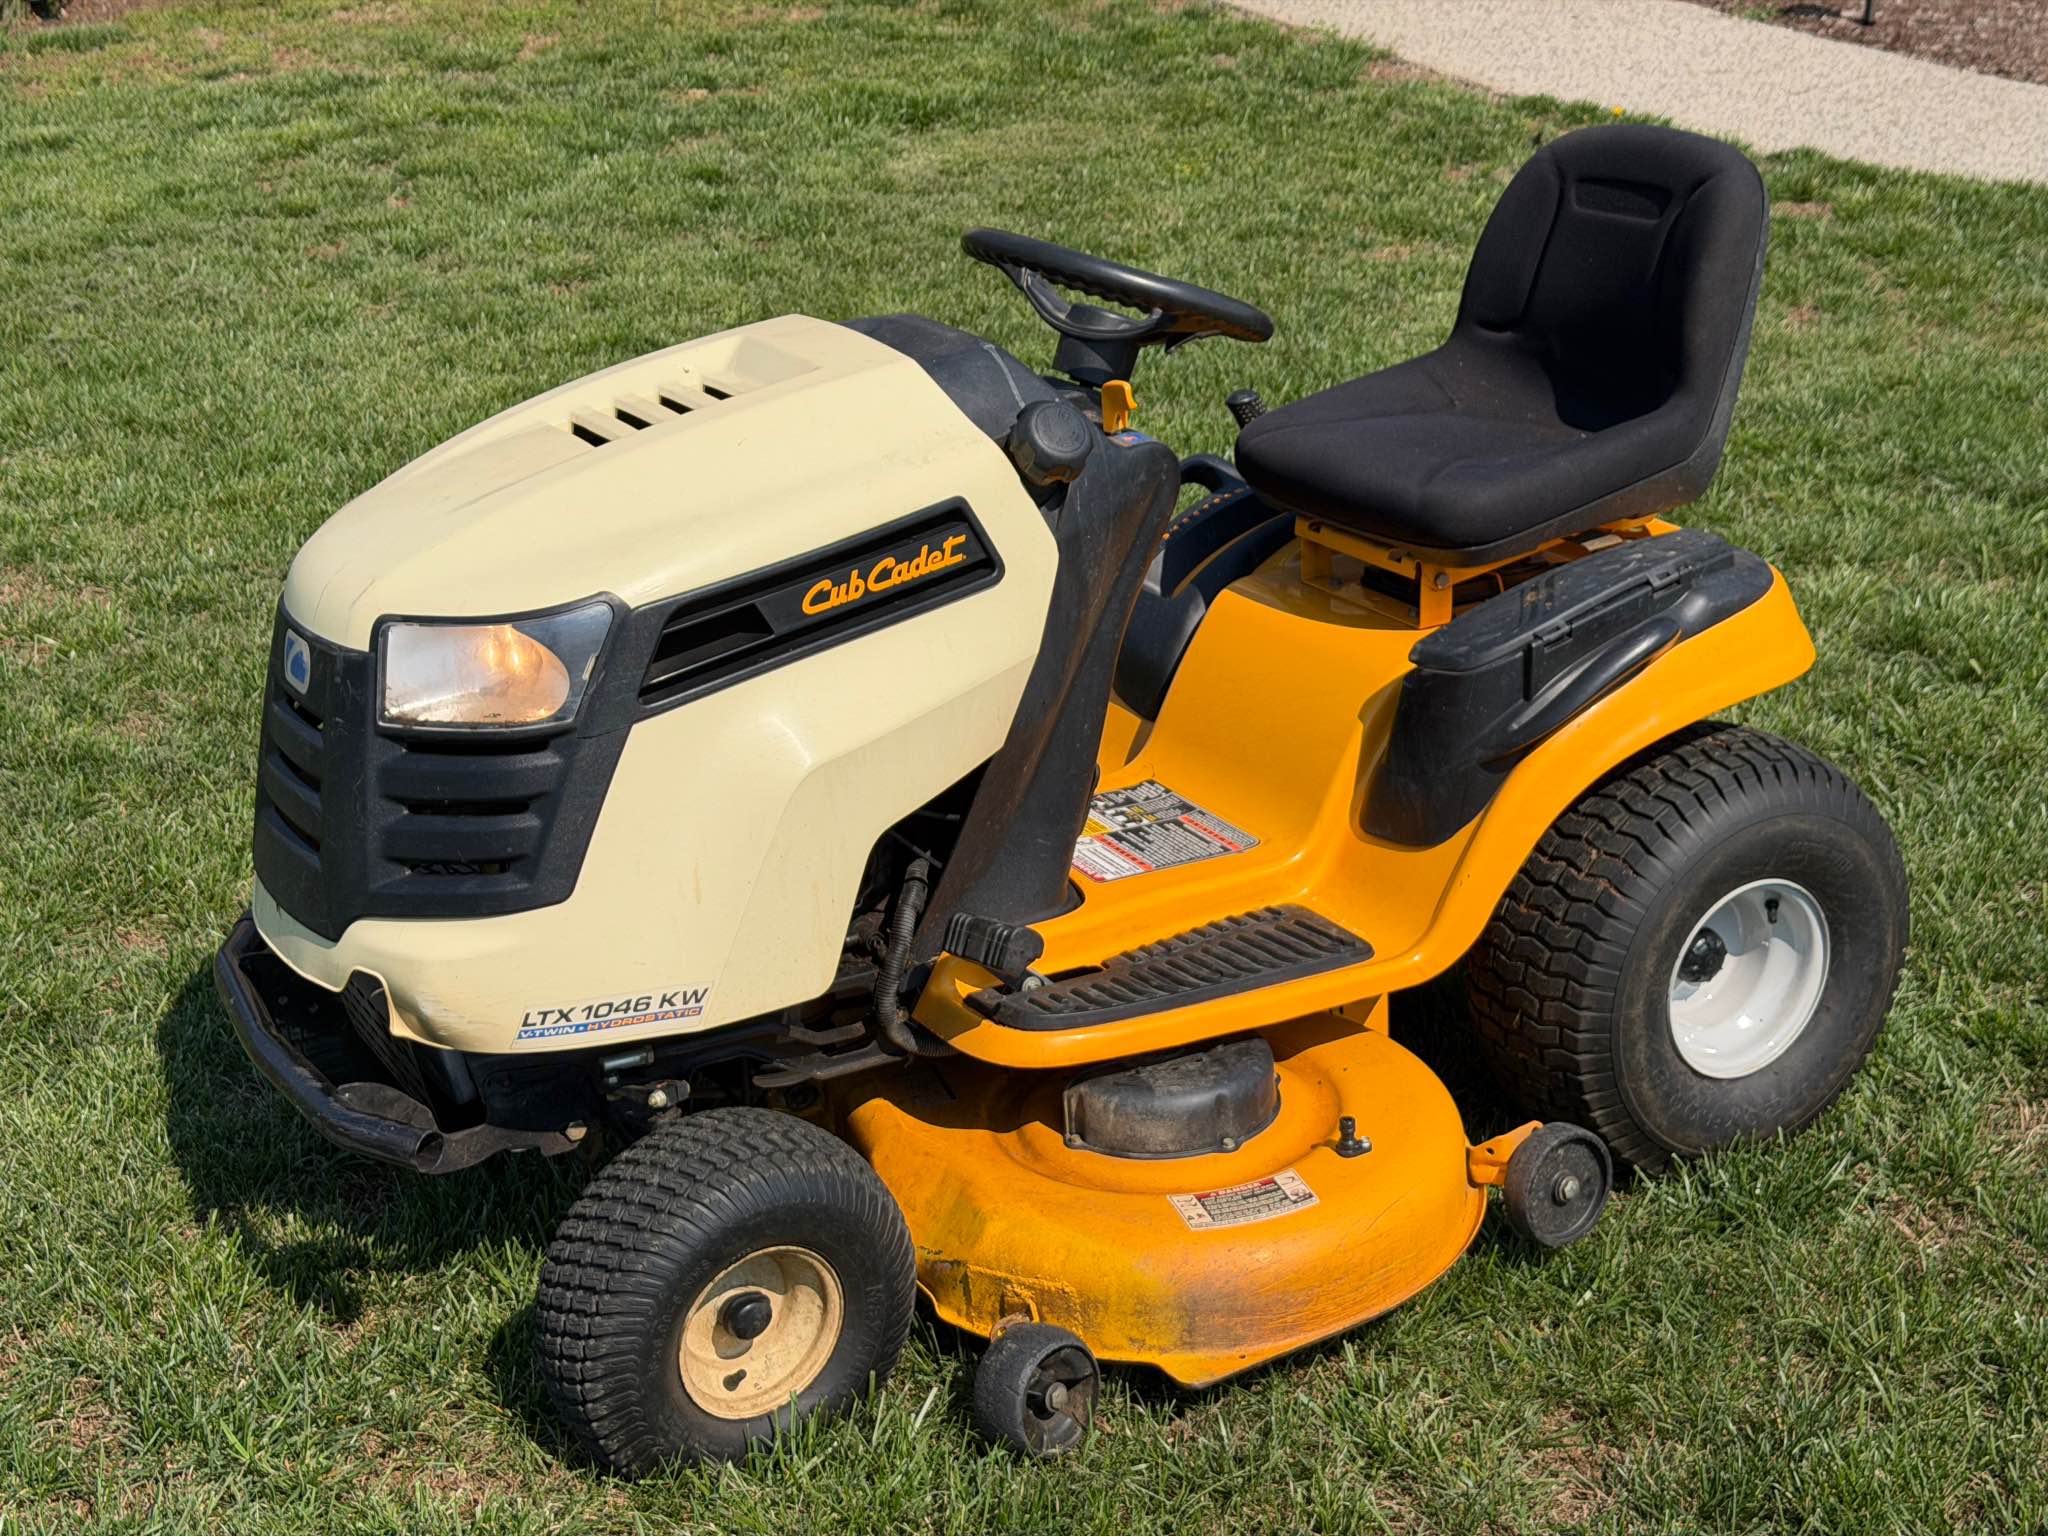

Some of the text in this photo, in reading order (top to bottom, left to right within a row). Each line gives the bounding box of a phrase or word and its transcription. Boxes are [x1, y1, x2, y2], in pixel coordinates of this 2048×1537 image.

[802, 534, 967, 615] Cub Cadet
[520, 1007, 700, 1039] V-TWIN HYDROSTATIC
[521, 987, 710, 1028] LTX 1046 KW
[1218, 1182, 1263, 1196] DANGER
